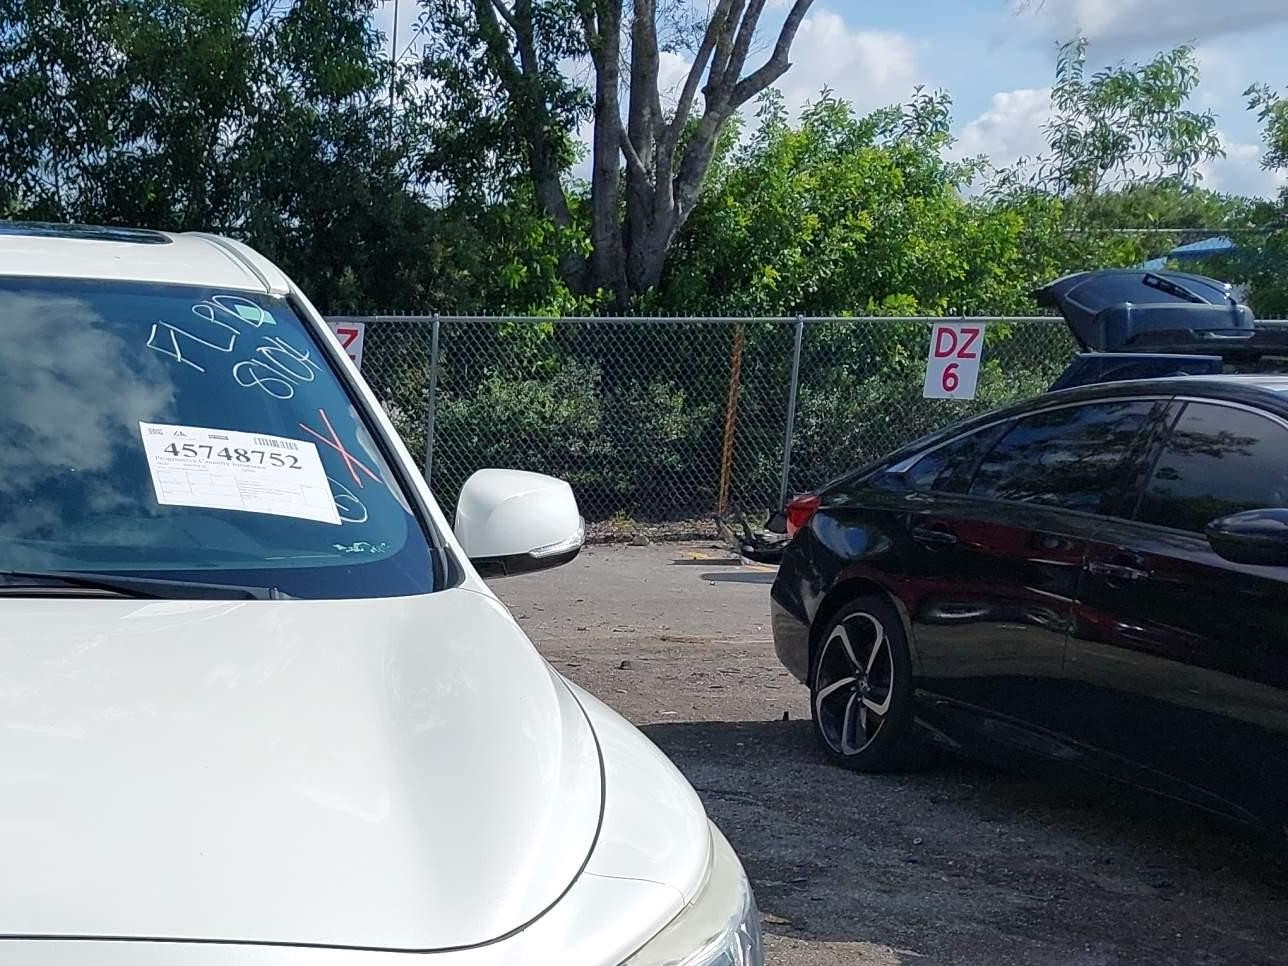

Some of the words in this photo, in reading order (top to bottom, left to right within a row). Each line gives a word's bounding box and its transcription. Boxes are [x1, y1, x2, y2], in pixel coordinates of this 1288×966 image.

[935, 327, 980, 359] DZ
[942, 362, 960, 392] 6
[163, 442, 302, 470] 45748752
